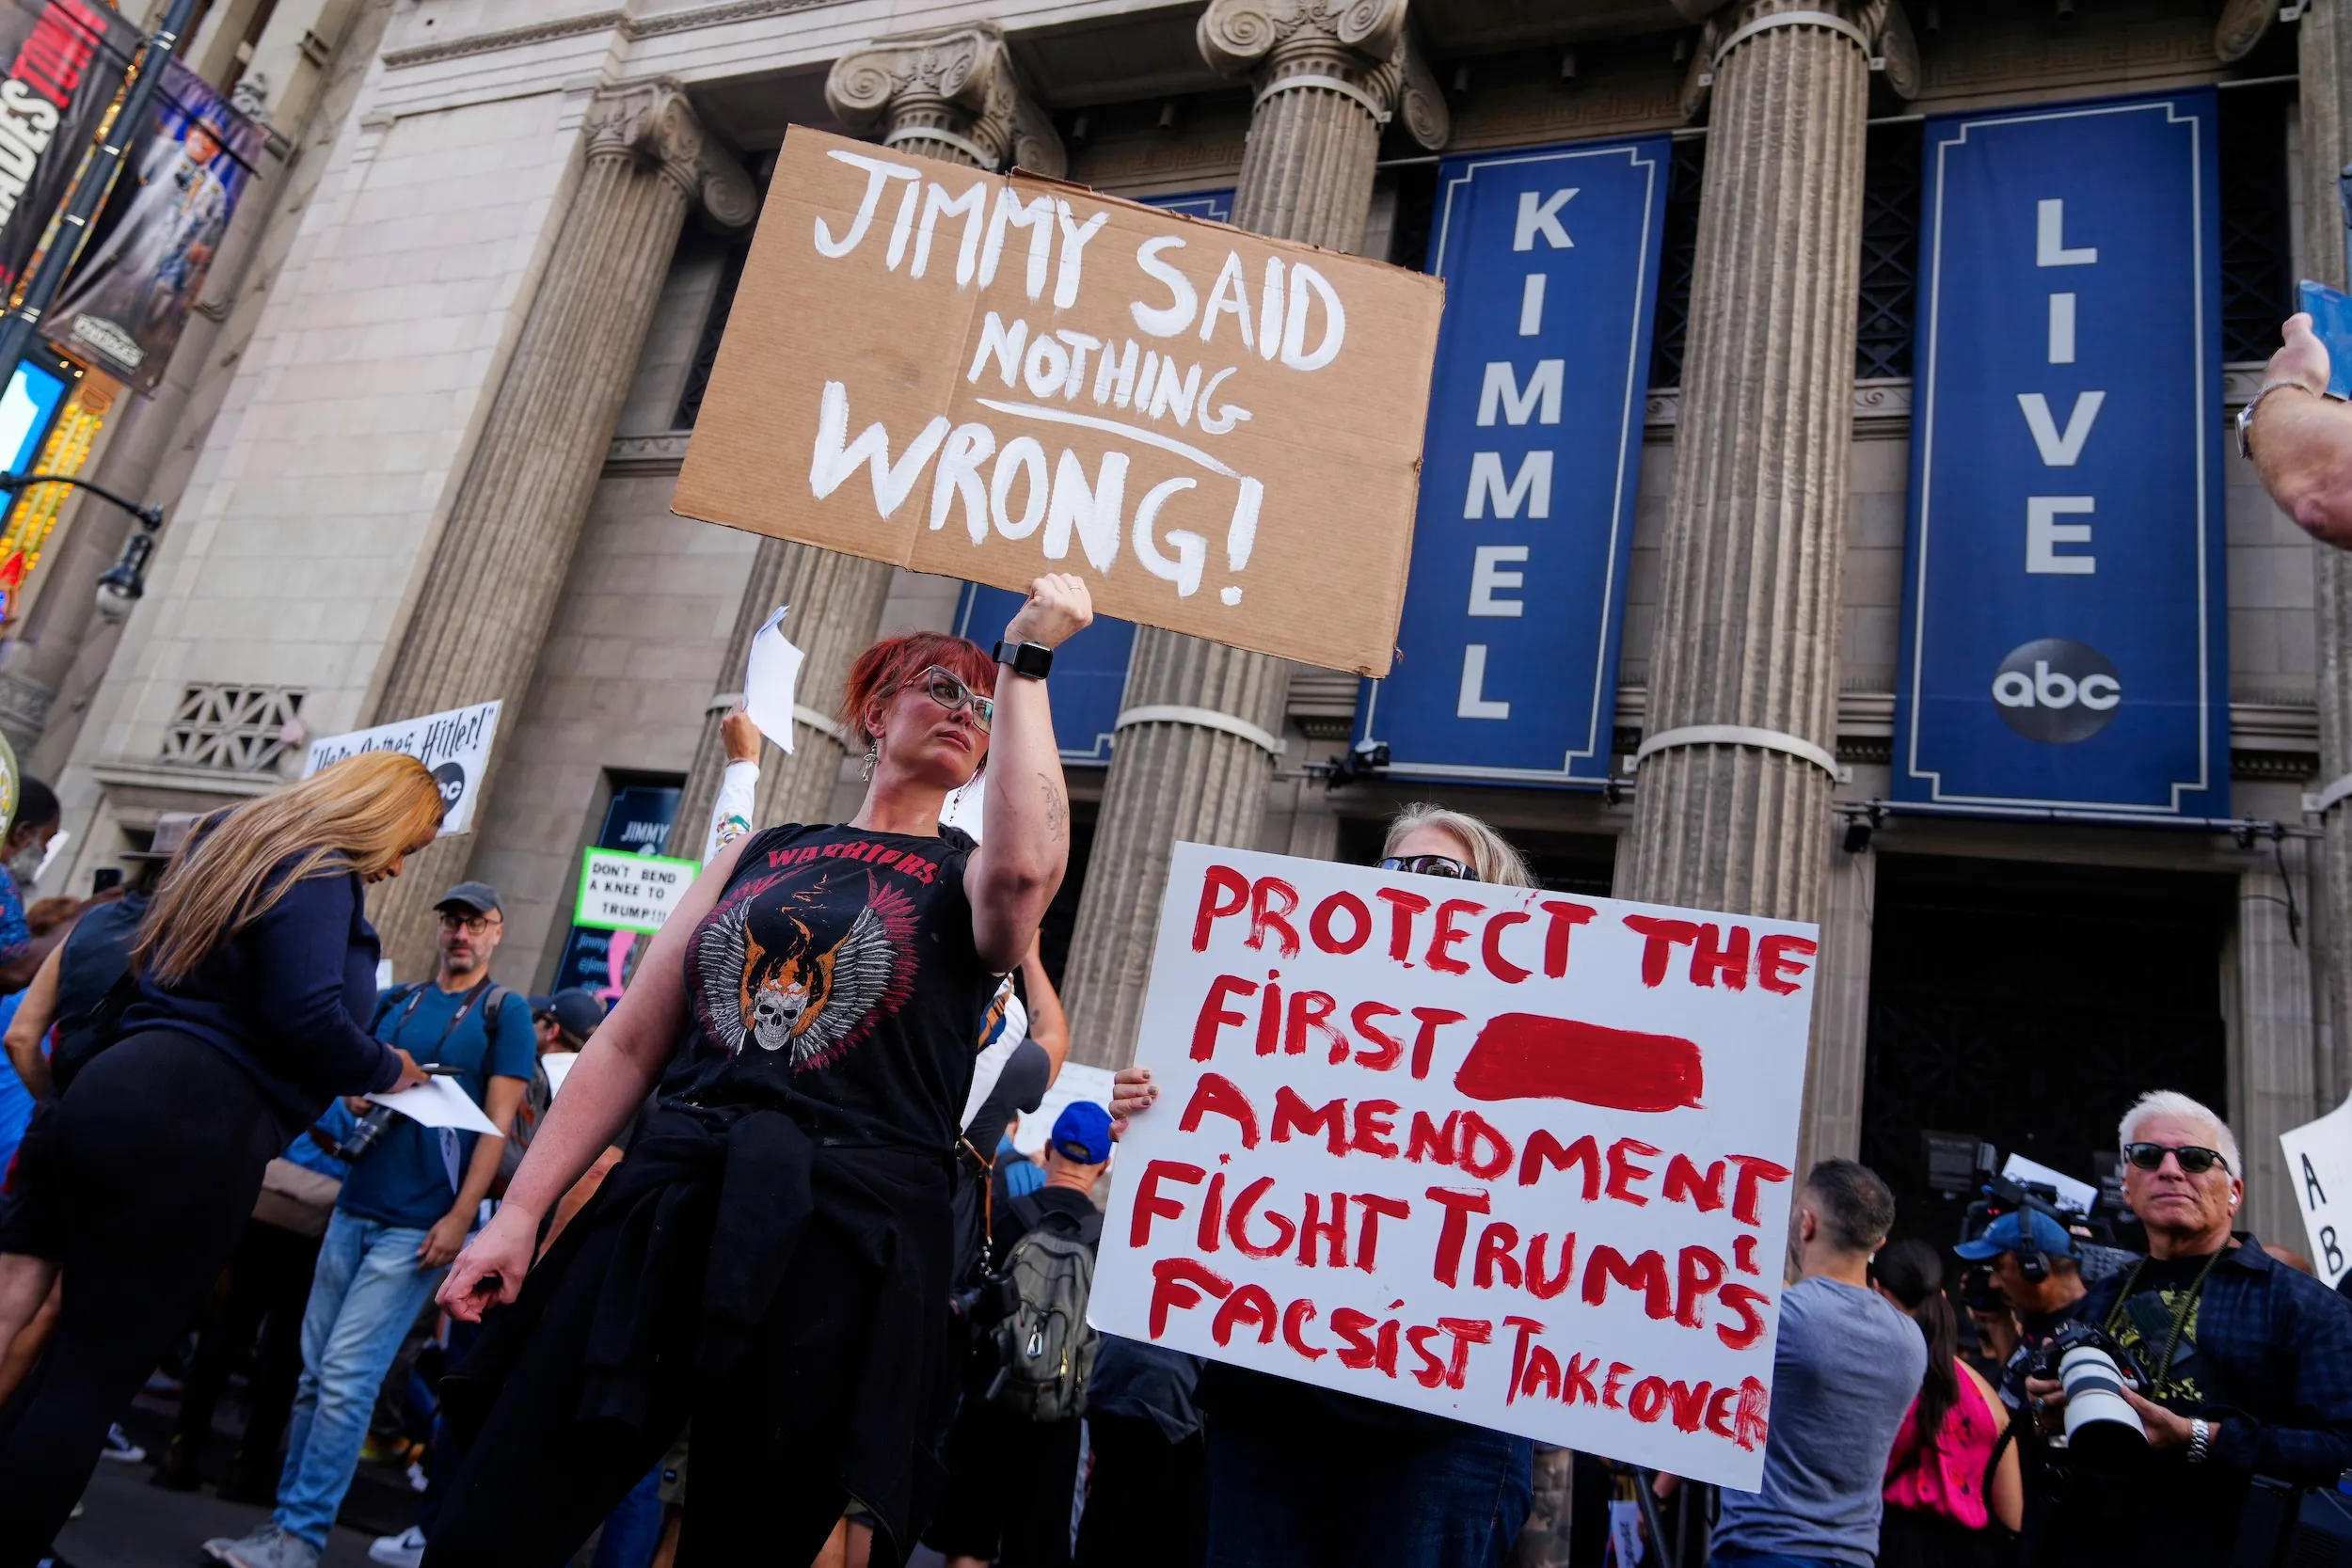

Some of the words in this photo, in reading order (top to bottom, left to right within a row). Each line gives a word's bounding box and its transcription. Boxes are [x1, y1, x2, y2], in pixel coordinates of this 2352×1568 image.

[813, 149, 1111, 310] JIMMY
[1130, 233, 1347, 372] SAID
[966, 310, 1253, 436] NOTHING
[2016, 198, 2106, 576] LIVE
[807, 380, 1265, 607] WRONG!
[1456, 186, 1581, 721] KIMMEL
[1992, 659, 2122, 711] abc
[589, 879, 597, 891] A
[604, 881, 640, 896] KNEE
[647, 887, 665, 899] TO
[592, 862, 629, 879] DON'T
[641, 869, 677, 884] BEND
[619, 820, 671, 845] JIMMY
[768, 840, 940, 886] WARRIORS
[1189, 863, 1598, 985] PROTECT
[1624, 913, 1819, 997] THE
[1178, 1072, 1794, 1228] AMENDMENT
[2300, 1151, 2328, 1212] A
[1424, 1186, 1772, 1352] TRUMP'S
[1503, 1315, 1770, 1454] TAKEOVER
